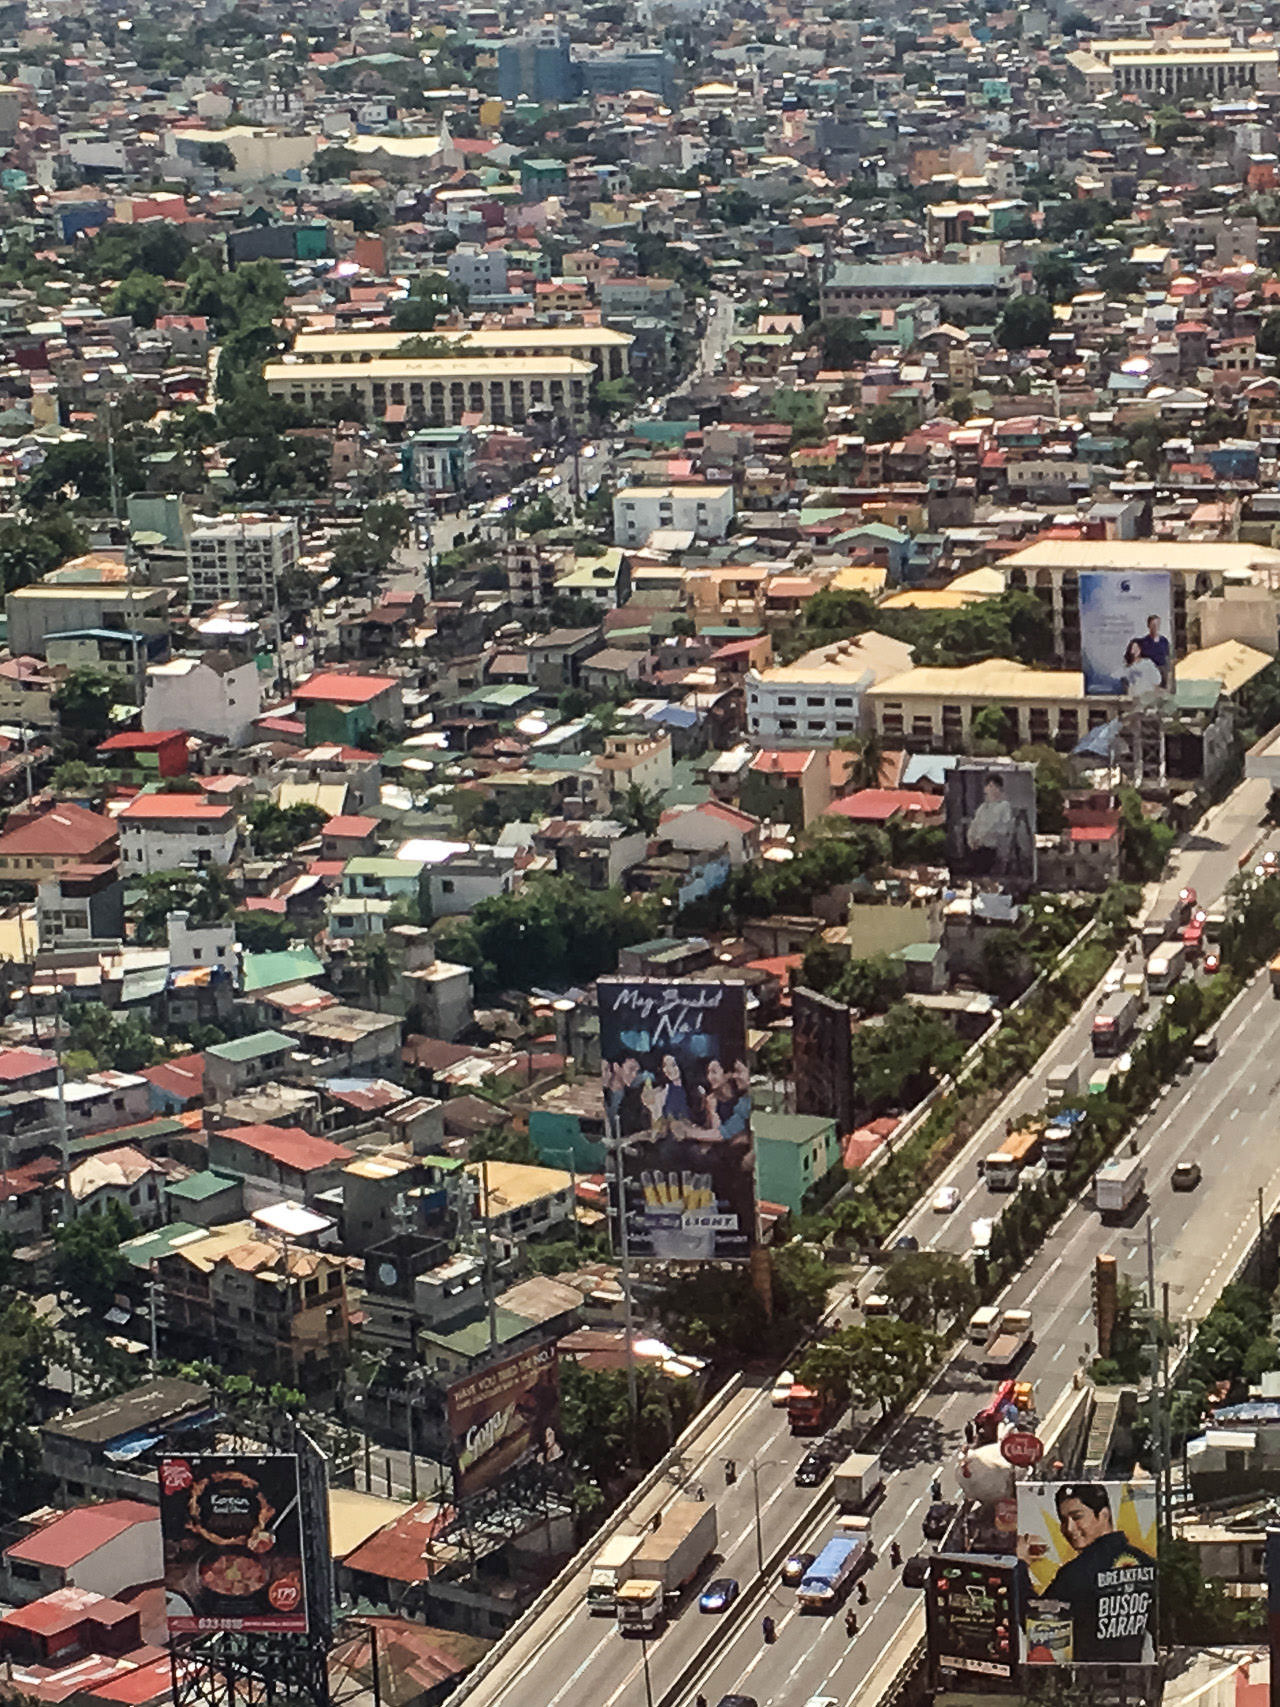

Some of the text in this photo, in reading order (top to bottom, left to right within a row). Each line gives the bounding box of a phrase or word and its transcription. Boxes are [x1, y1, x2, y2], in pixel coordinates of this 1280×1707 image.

[684, 1217, 734, 1227] LIGHT
[210, 1494, 251, 1506] Korean
[1097, 1567, 1155, 1588] BREAKFAST
